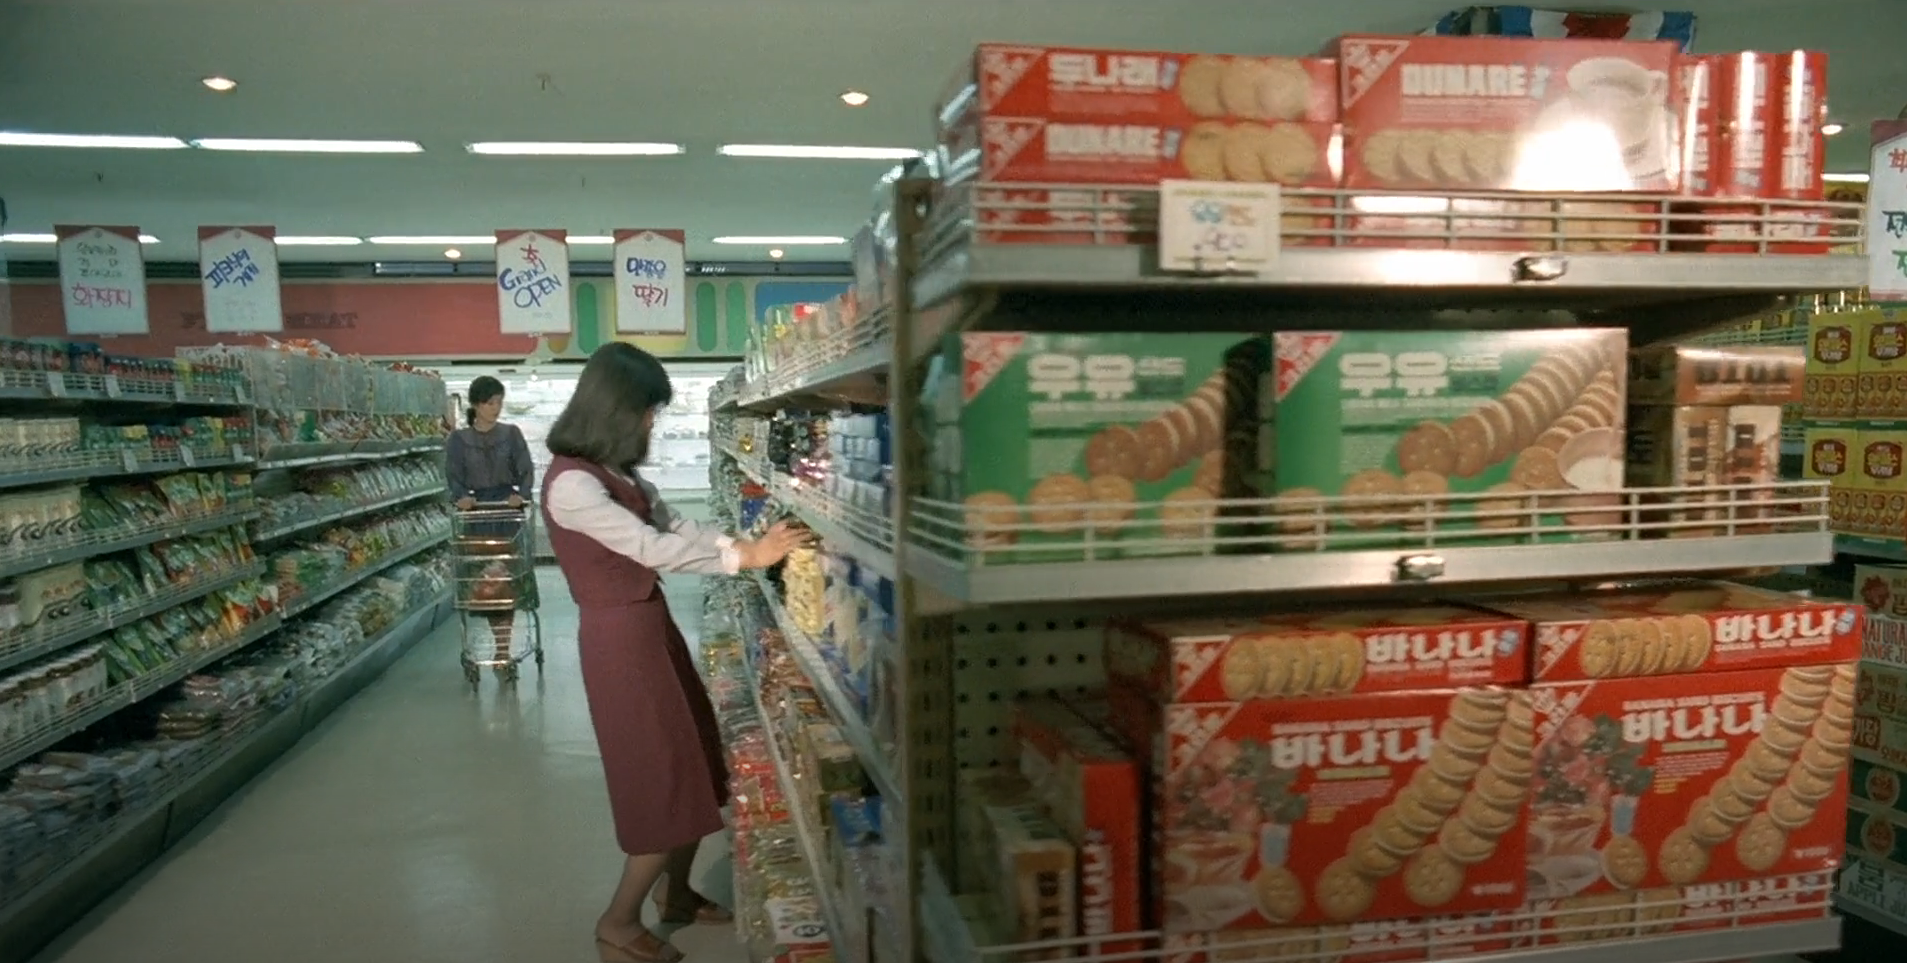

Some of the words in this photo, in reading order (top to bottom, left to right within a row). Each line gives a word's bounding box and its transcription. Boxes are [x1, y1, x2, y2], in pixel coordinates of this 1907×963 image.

[1401, 63, 1528, 97] DUNARE
[1027, 354, 1136, 399] 우유
[1339, 352, 1449, 397] 우유
[1366, 629, 1498, 663] 바나나
[1714, 609, 1837, 643] 바나나
[1620, 702, 1767, 743] 바나나
[1270, 728, 1435, 769] 바나나
